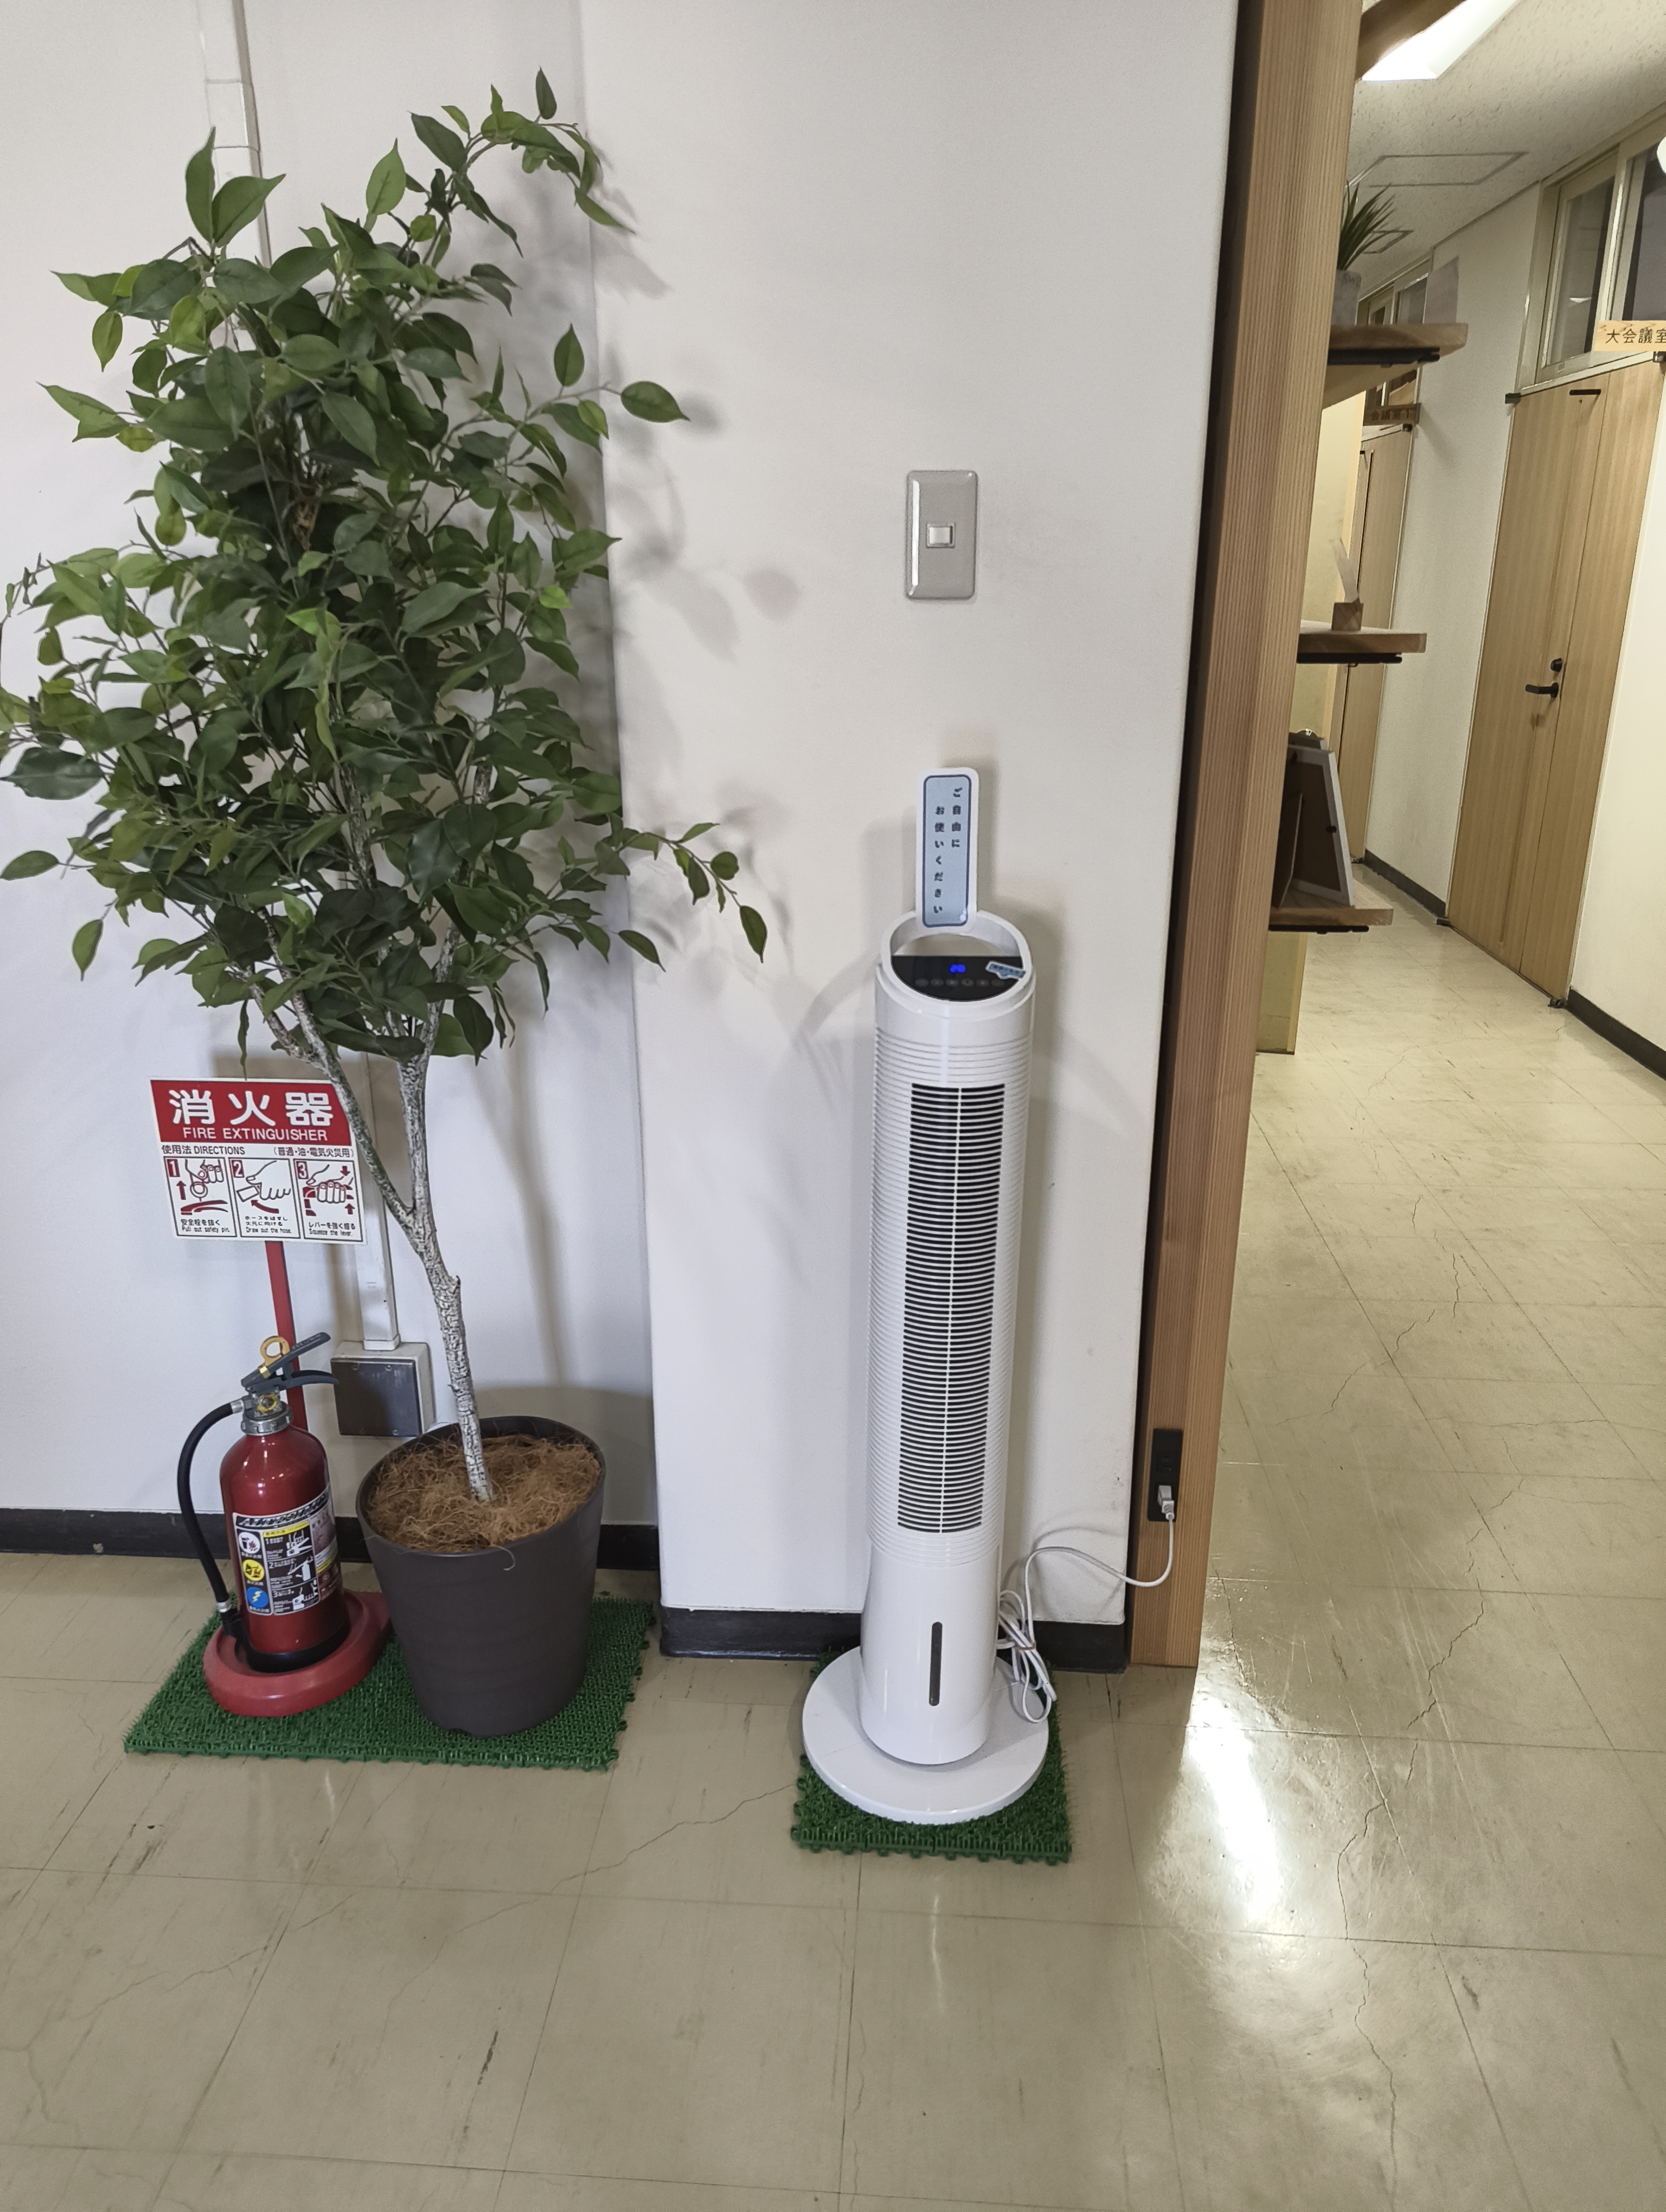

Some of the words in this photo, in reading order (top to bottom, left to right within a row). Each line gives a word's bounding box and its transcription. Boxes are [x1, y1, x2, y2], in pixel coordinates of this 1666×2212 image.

[1605, 328, 1666, 344] 大会議室
[951, 787, 963, 848] ご自由に
[933, 806, 945, 914] お使いください
[169, 1089, 334, 1127] 消火器
[183, 1127, 216, 1139] FIRE
[222, 1128, 328, 1141] EXTINGUISHER
[162, 1145, 192, 1154] 使用法
[194, 1146, 246, 1155] DIRECTIONS
[170, 1160, 177, 1176] 1
[233, 1161, 243, 1177] 2
[299, 1162, 307, 1179] 3
